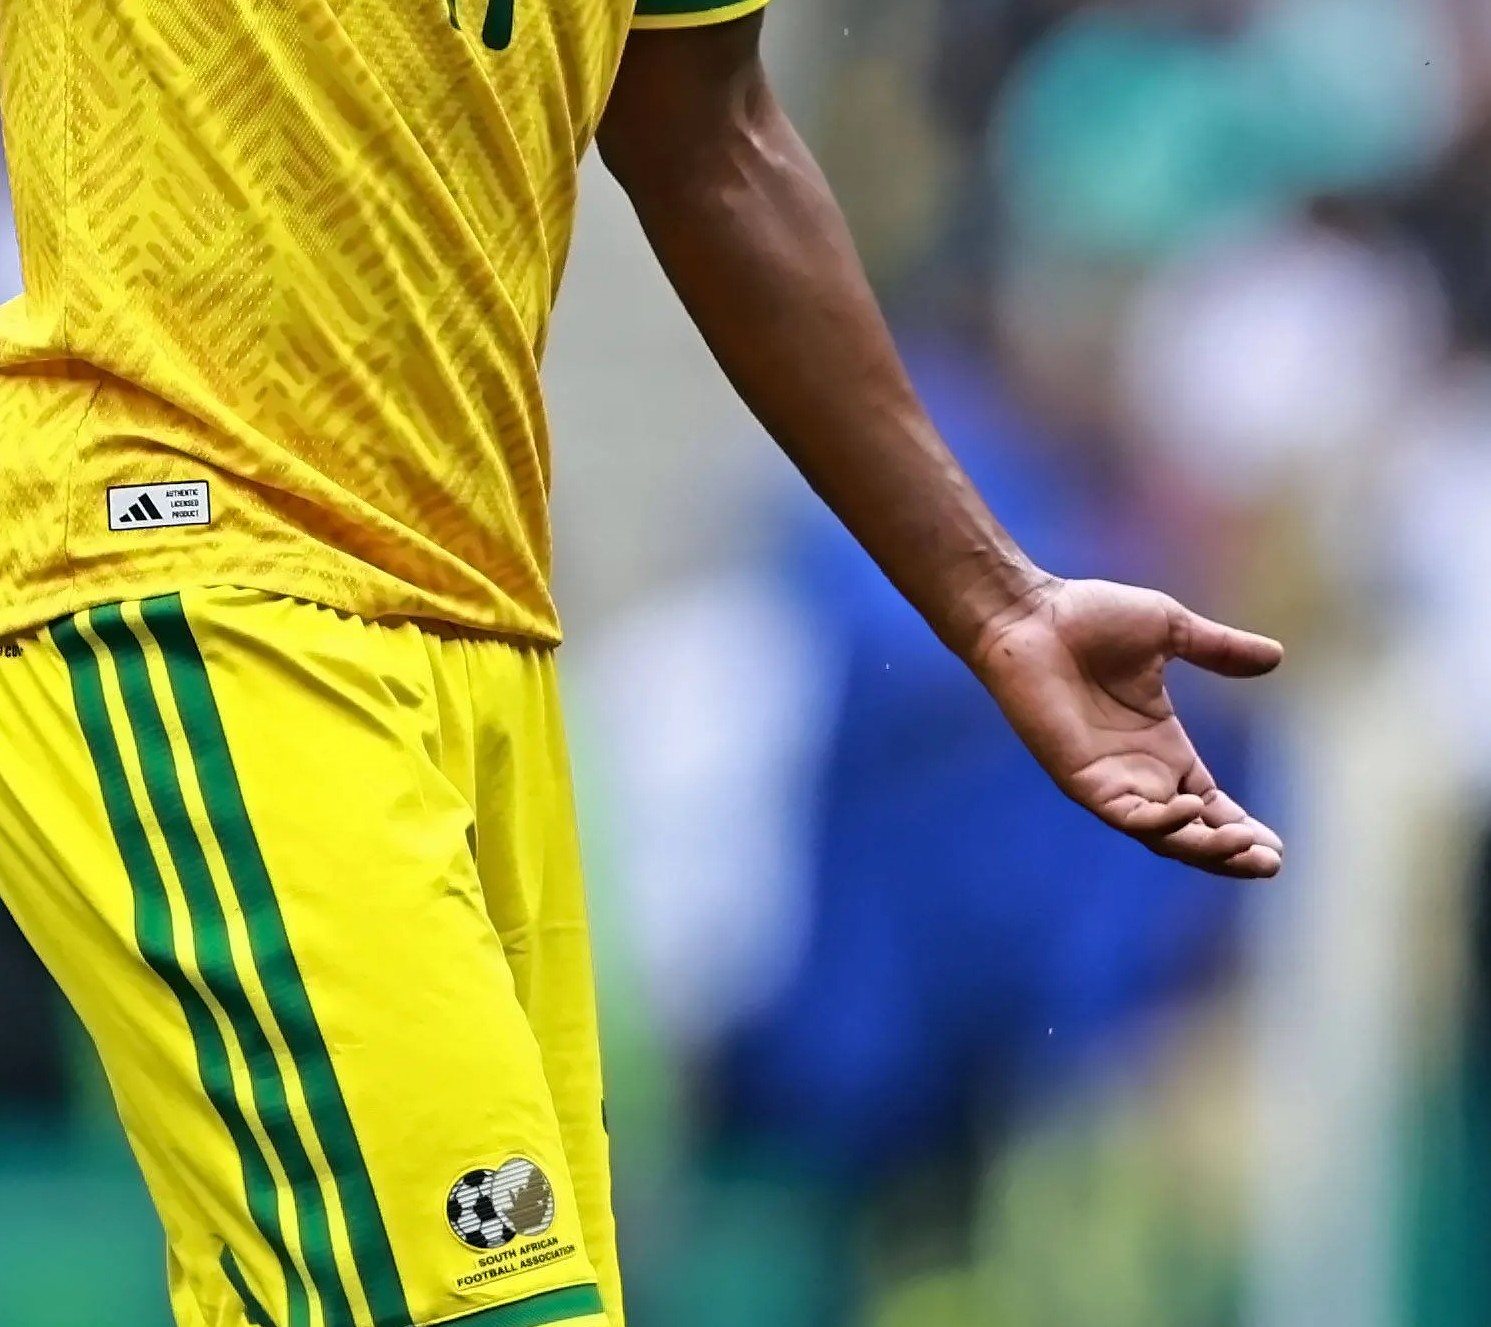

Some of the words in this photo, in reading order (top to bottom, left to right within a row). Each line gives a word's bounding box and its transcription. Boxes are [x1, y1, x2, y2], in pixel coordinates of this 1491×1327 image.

[170, 498, 200, 509] LICENSED
[171, 509, 200, 519] PRODUCT
[478, 1248, 517, 1268] SOUTH
[519, 1236, 559, 1256] AFRICAN
[456, 1263, 517, 1287] FOOTBALL
[520, 1244, 576, 1269] ASSOCIATION
